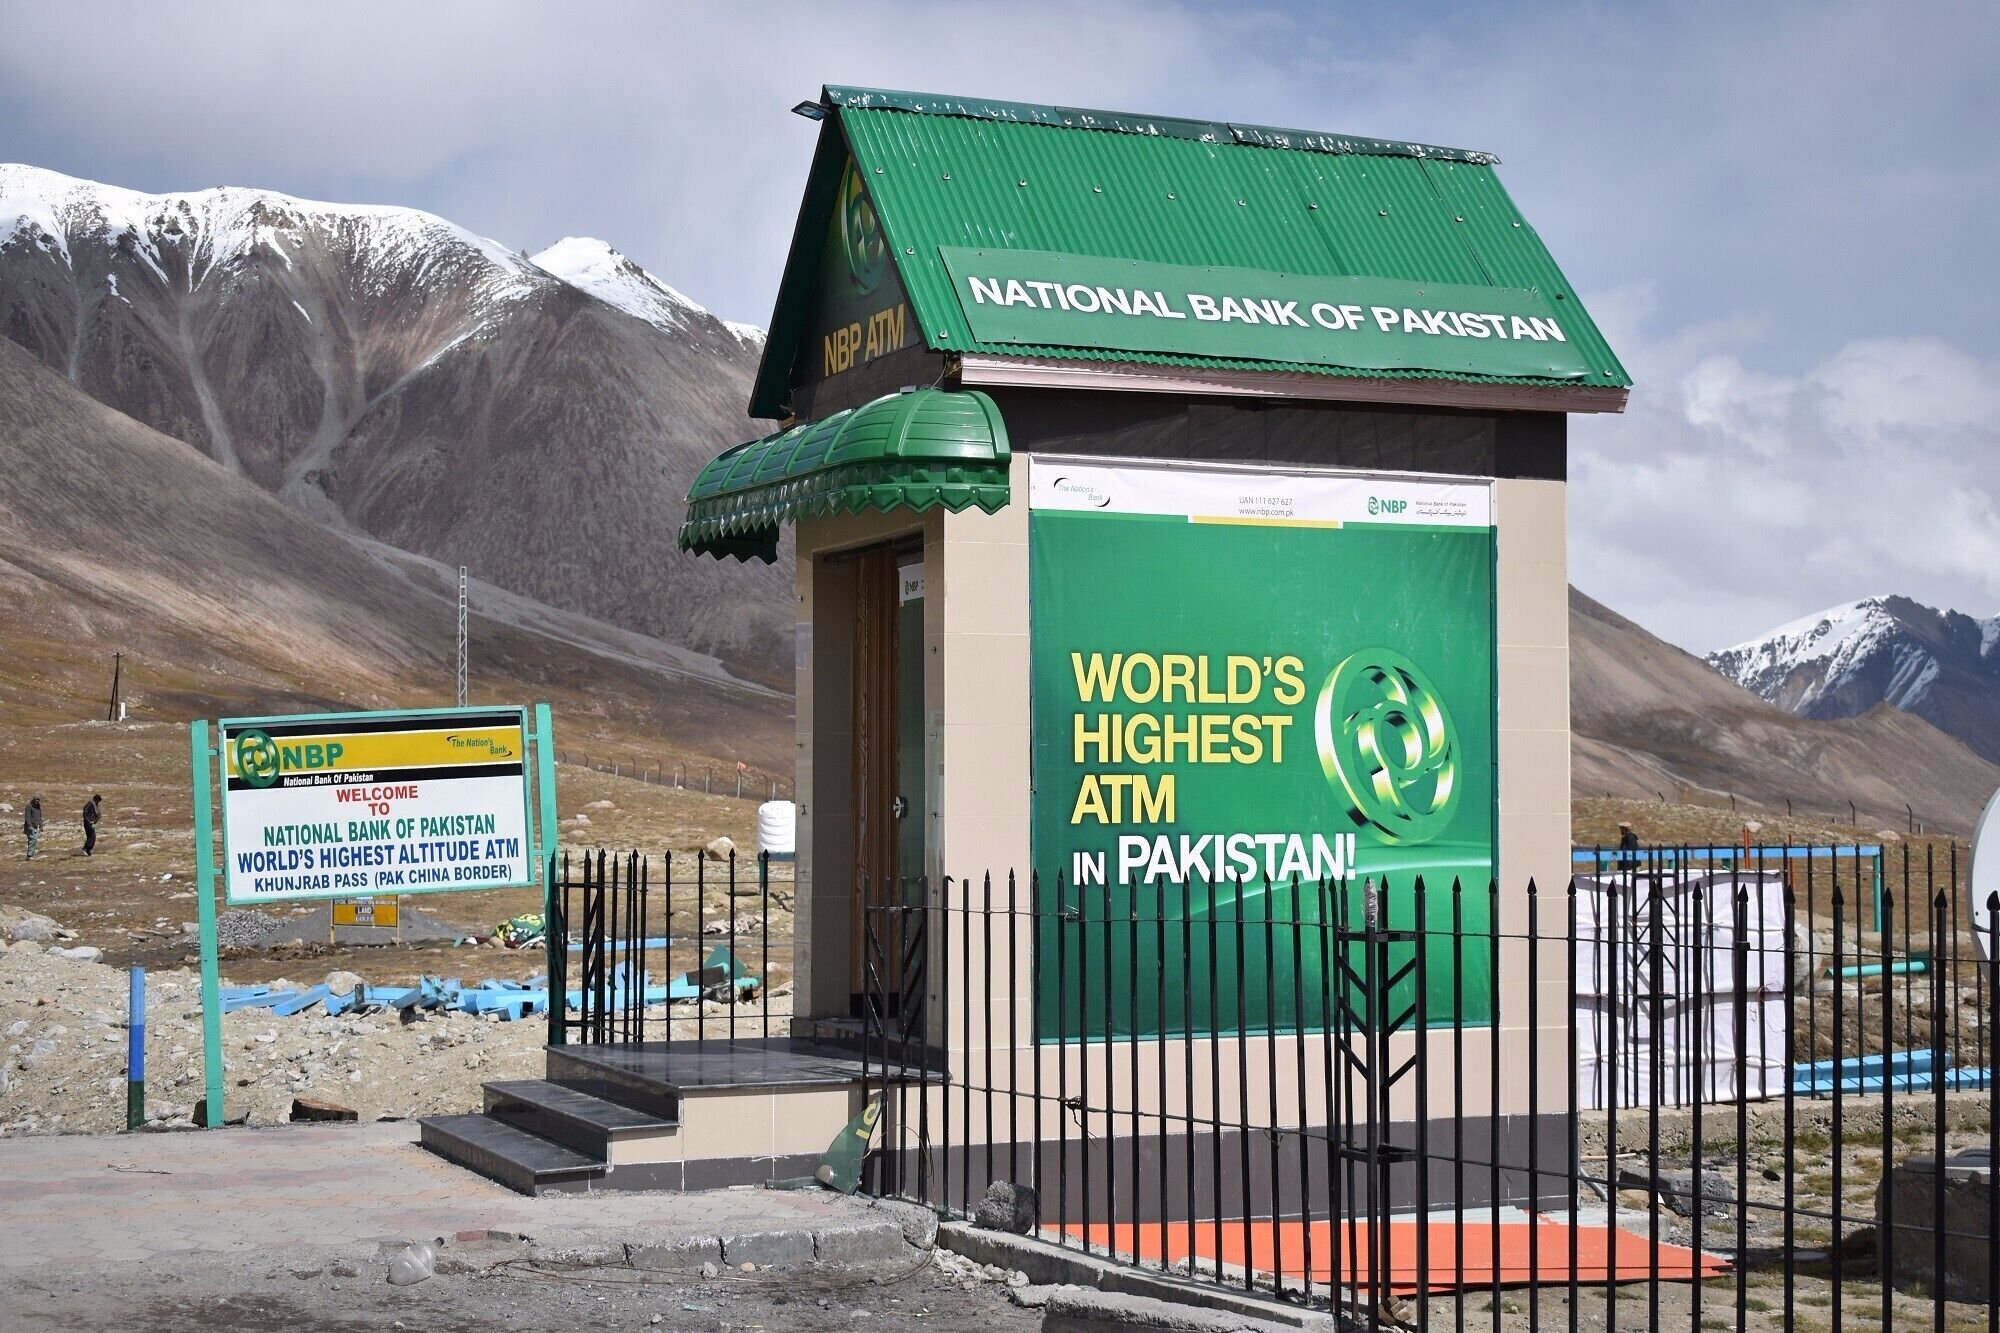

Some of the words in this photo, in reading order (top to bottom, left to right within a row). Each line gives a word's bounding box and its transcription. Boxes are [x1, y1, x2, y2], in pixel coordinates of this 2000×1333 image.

[968, 276, 1187, 319] NATIONAL
[1187, 293, 1310, 327] BANK
[1311, 302, 1366, 331] OF
[1370, 306, 1567, 342] PAKISTAN
[824, 322, 862, 377] NBP
[864, 303, 904, 362] ATM
[1239, 496, 1254, 504] UAN
[1255, 497, 1266, 505] 111
[1268, 497, 1279, 505] 627
[1281, 498, 1293, 506] 627
[1239, 508, 1294, 518] www.nbp.com.pk
[1381, 500, 1407, 514] NBP
[1071, 653, 1306, 705] WORLD'S
[452, 738, 465, 748] The
[466, 737, 493, 747] Nation's
[489, 745, 507, 755] Bank
[1074, 713, 1293, 764] HIGHEST
[282, 743, 344, 770] NBP
[284, 775, 313, 787] National
[314, 774, 332, 785] Bank
[333, 773, 343, 784] Of
[343, 772, 374, 783] Pakistan
[336, 785, 418, 802] WELCOME
[1071, 775, 1175, 824] ATM
[368, 803, 390, 816] TO
[264, 823, 343, 846] NATIONAL
[348, 818, 391, 842] BANK
[396, 818, 415, 839] OF
[421, 814, 495, 837] PAKISTAN
[238, 848, 315, 873] WORLD'S
[320, 844, 395, 868] HIGHEST
[399, 840, 480, 864] ALTITUDE
[485, 837, 519, 860] ATM
[1073, 851, 1105, 885] IN
[1118, 833, 1356, 885] PAKISTAN!
[255, 873, 330, 892] KHUNJRAB
[335, 872, 368, 888] PASS
[375, 870, 405, 889] (PAK
[409, 867, 450, 884] CHINA
[455, 864, 512, 882] BORDER)
